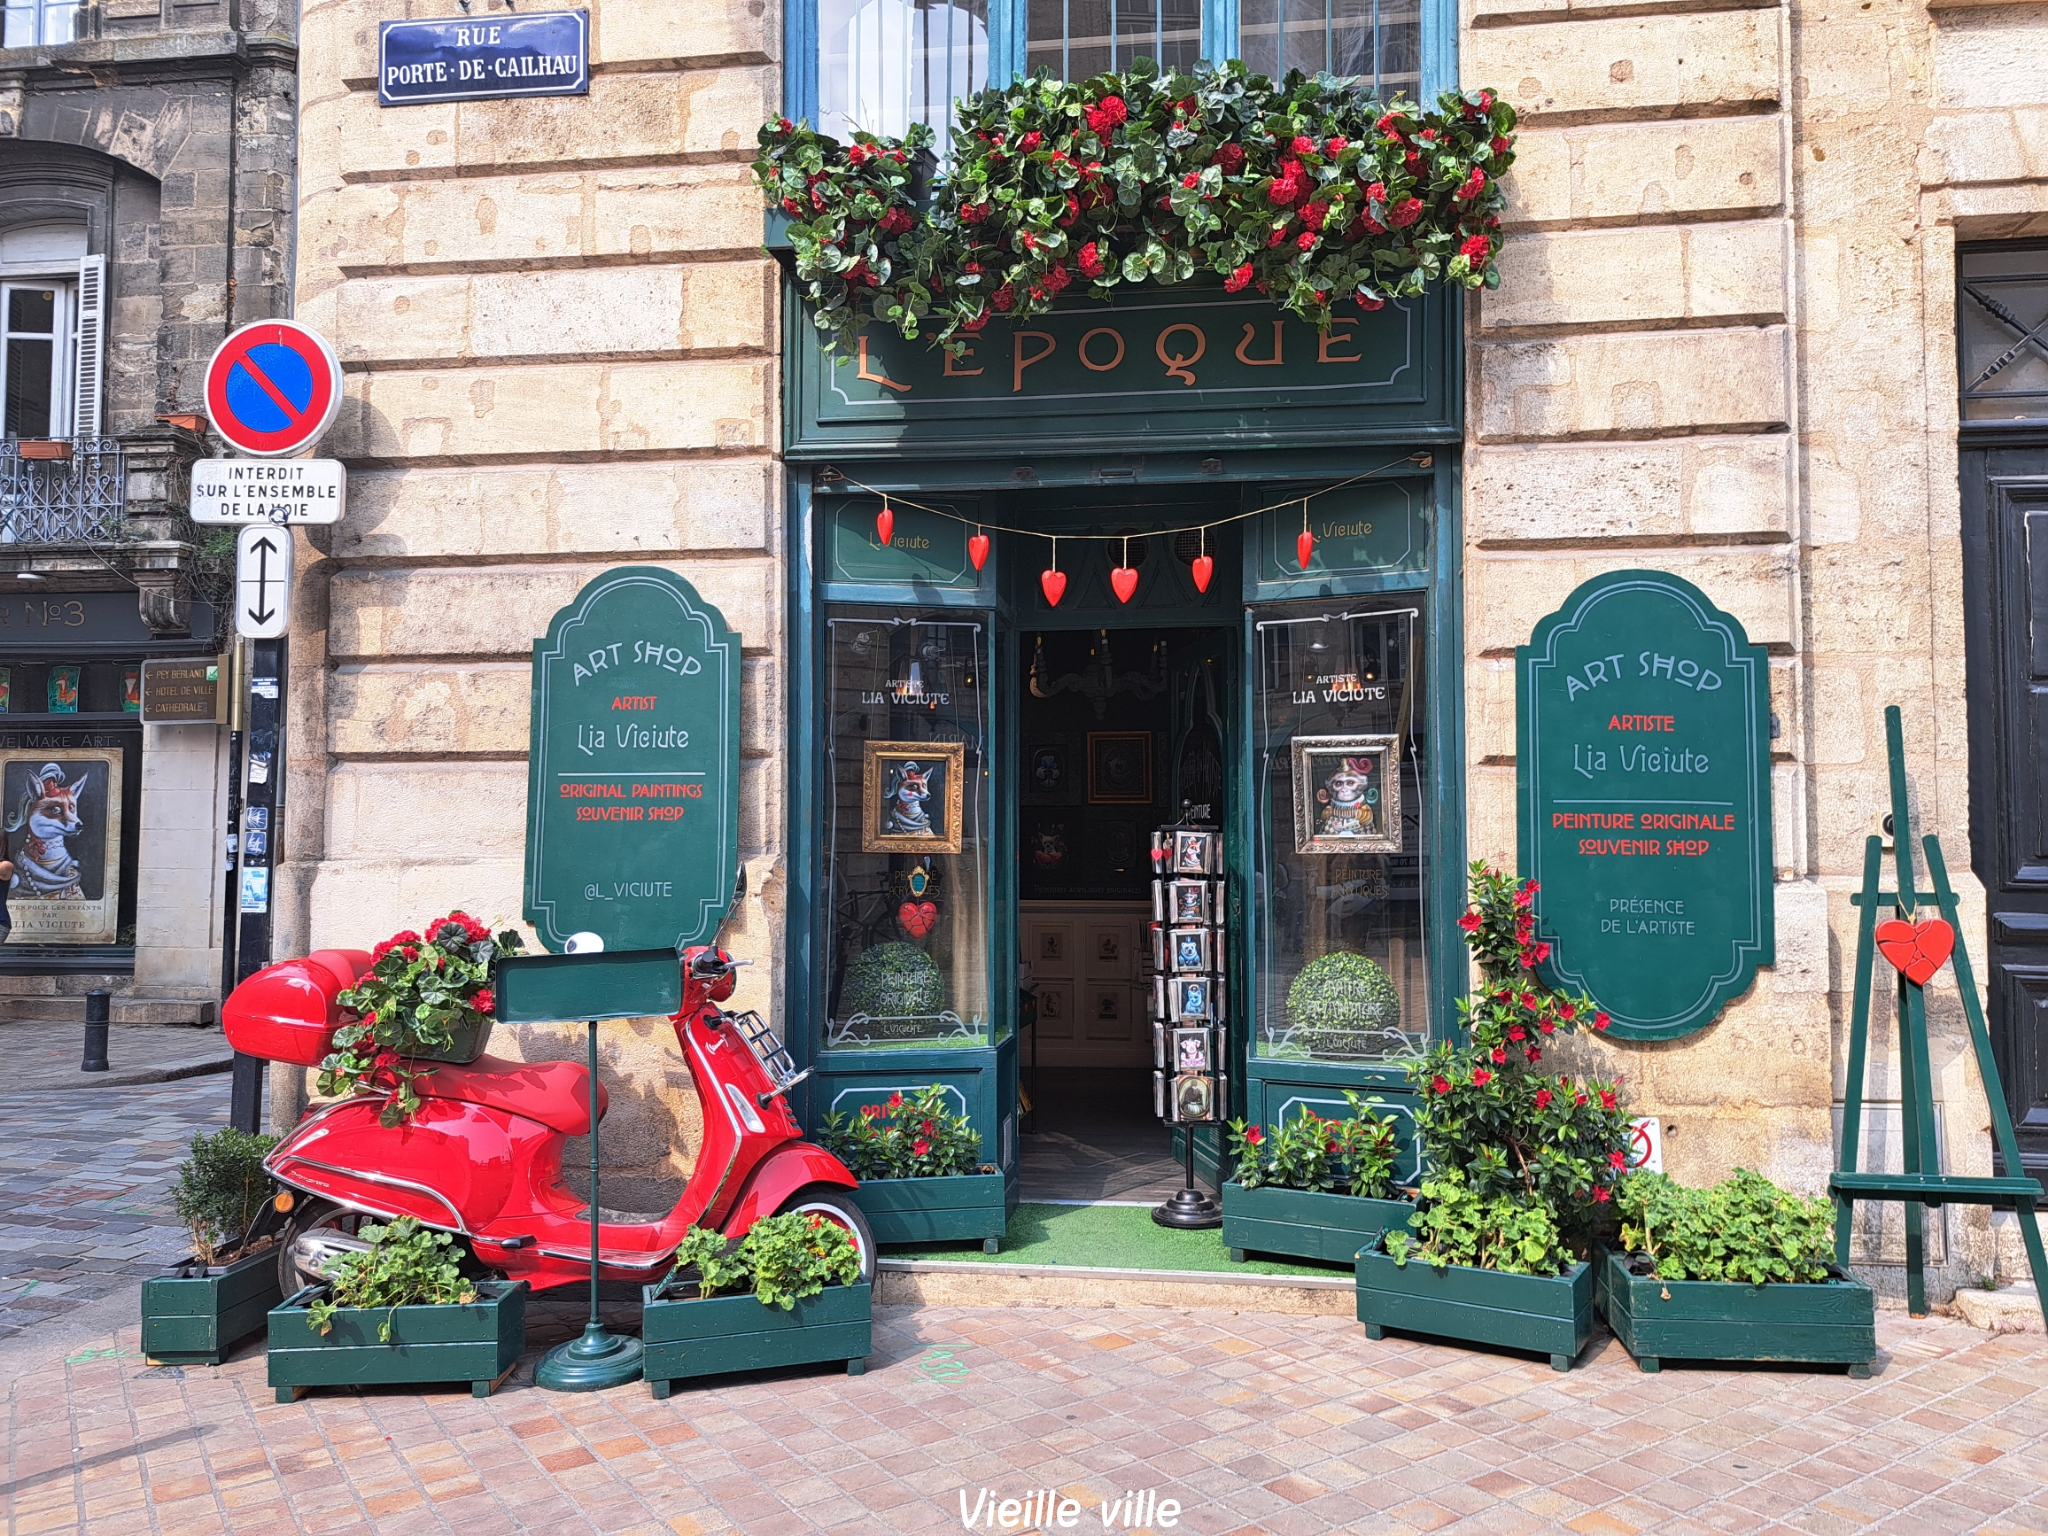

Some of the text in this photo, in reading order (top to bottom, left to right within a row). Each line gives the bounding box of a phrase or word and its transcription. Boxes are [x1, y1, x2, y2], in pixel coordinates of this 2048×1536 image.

[456, 26, 501, 47] RUE
[228, 467, 304, 480] INTERDIT
[196, 485, 337, 498] SUR L'ENSEMBLE
[221, 503, 241, 516] DE
[247, 503, 266, 516] LA
[1322, 520, 1373, 538] Viciute
[573, 640, 702, 687] ART SHOP
[156, 668, 205, 680] PEY BERLAND
[1316, 673, 1357, 685] ARTISTE
[1566, 651, 1723, 702] ART SHOP
[180, 685, 191, 696] DE
[193, 685, 214, 695] VILLE
[885, 679, 925, 688] ARTISTE
[611, 696, 657, 711] ARTIST
[861, 691, 950, 705] LIA VICIUTE
[1292, 687, 1386, 705] LIA VICIUTE
[1608, 714, 1675, 732] ARTISTE
[25, 734, 71, 748] MAKE
[577, 723, 689, 756] Lia Viciute
[1573, 744, 1709, 779] Lia Viciute
[560, 783, 703, 799] ORIGINAL PAINTINGS
[576, 806, 685, 821] SOUVENIR SHOP
[1552, 813, 1736, 831] PEINTURE ORIGINALE
[1578, 839, 1710, 856] SOUVENIR SHOP
[1335, 868, 1383, 883] PEINTURE
[584, 881, 673, 901] @L_VICIUTE
[1609, 894, 1685, 914] PRÉSENCE
[14, 920, 86, 929] LIA VICIUTE
[1601, 919, 1696, 935] DE L'ARTISTE
